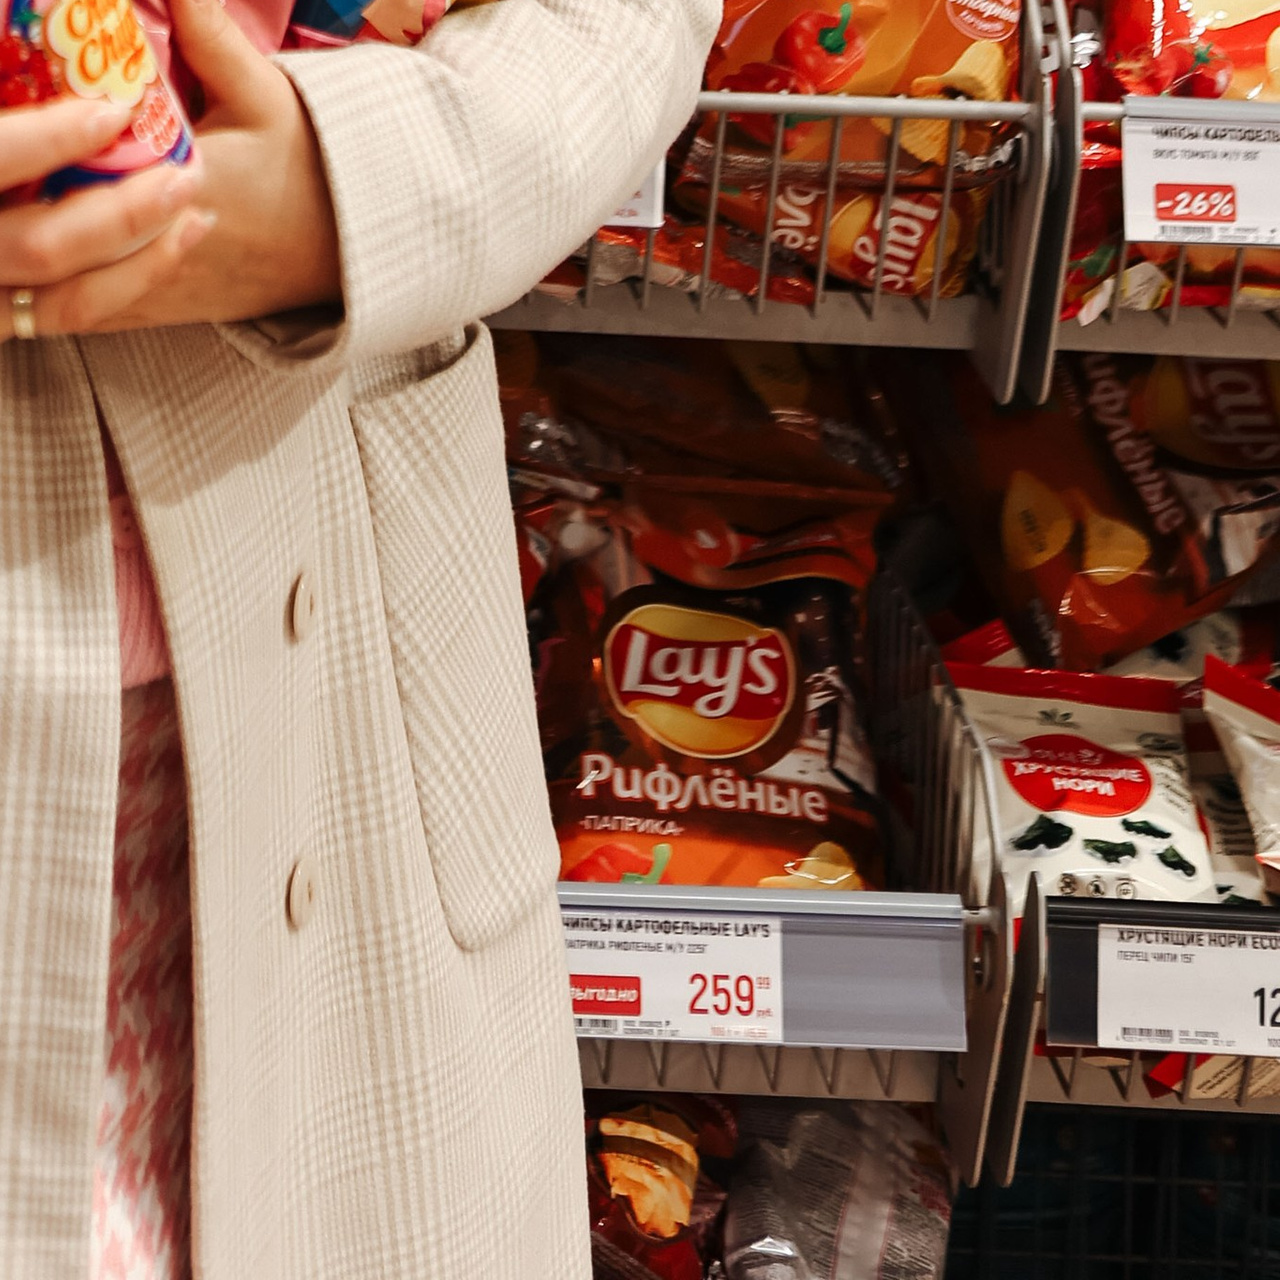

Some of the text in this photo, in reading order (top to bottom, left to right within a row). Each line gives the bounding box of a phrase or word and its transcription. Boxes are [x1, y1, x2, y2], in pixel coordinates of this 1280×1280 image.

[1156, 190, 1236, 218] -26%
[620, 629, 783, 719] Lay's
[579, 753, 829, 822] Рифлёные
[1051, 776, 1116, 798] НОРИ
[562, 917, 771, 938] ЧИПСЫ КАРТОФЕЛЬНЫЕ LAY'S
[1117, 927, 1248, 949] ХРУСТЯЩИЕ НОРИ
[1117, 950, 1150, 963] ПЕРЕЦ
[688, 973, 755, 1016] 259
